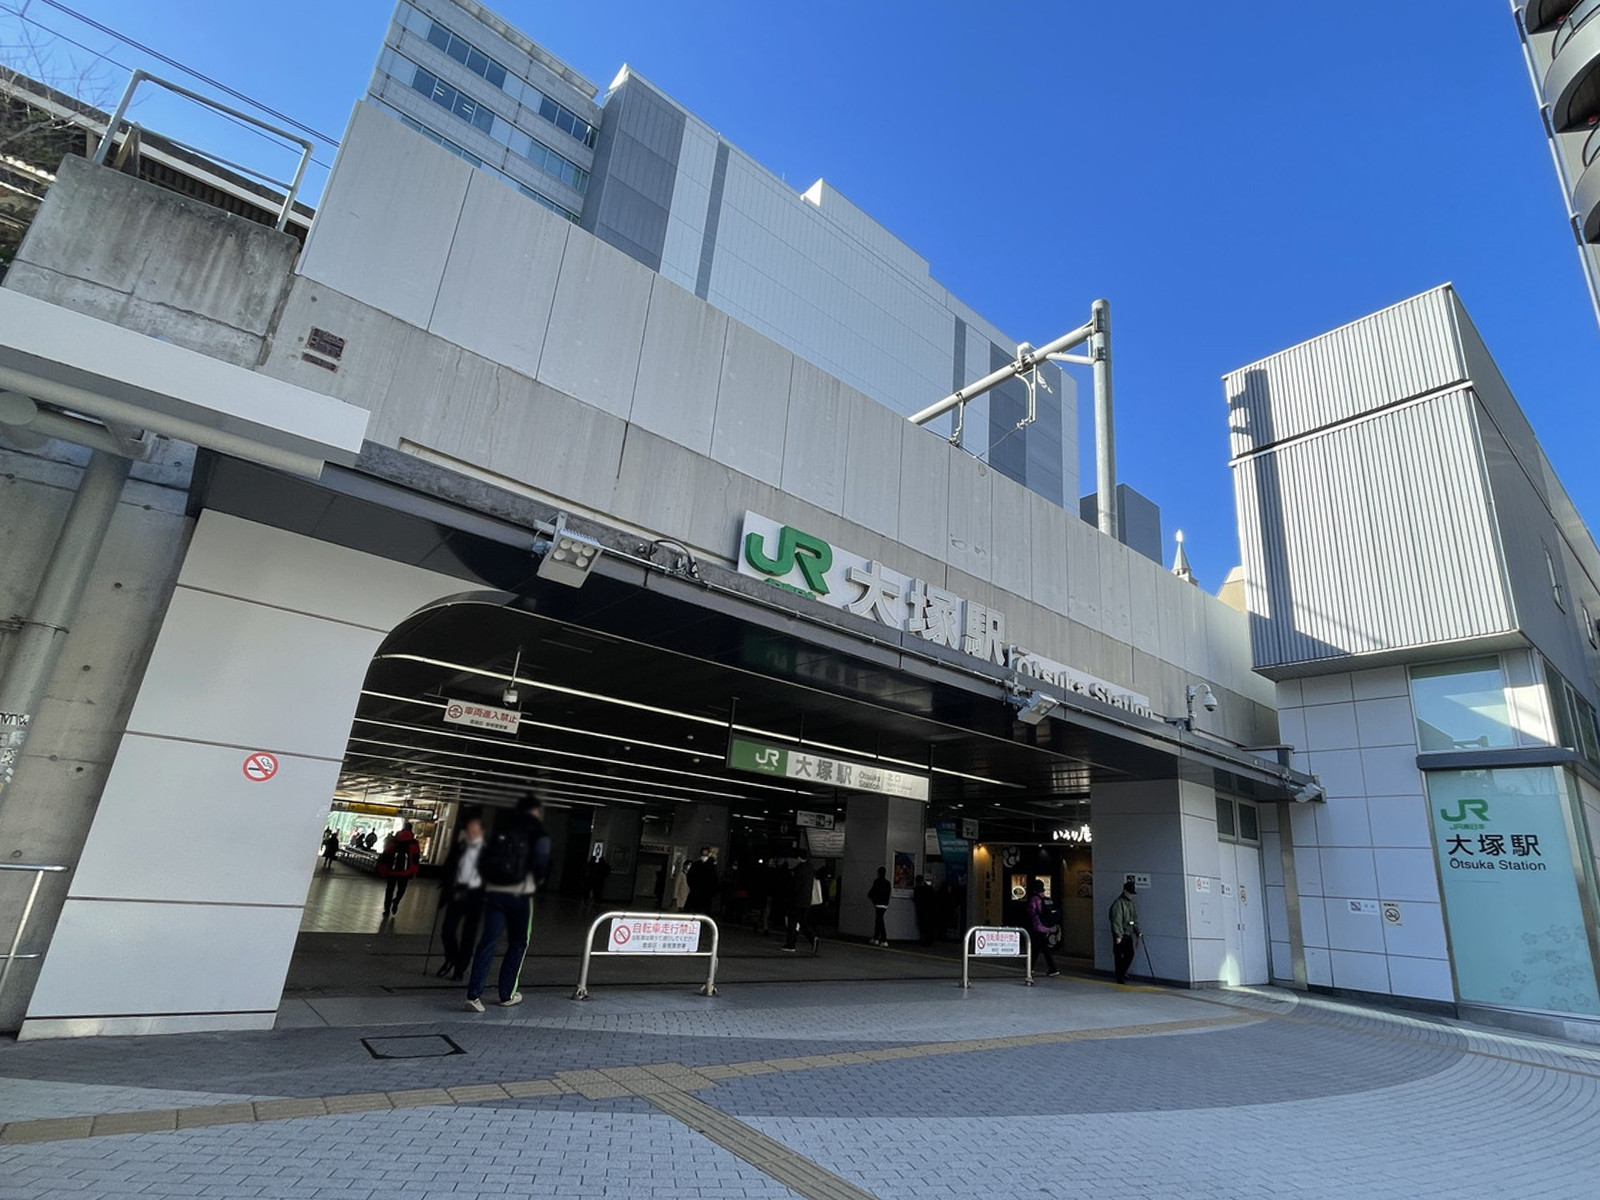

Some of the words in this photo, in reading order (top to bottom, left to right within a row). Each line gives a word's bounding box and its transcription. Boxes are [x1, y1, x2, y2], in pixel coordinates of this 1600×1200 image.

[745, 525, 833, 596] JR
[843, 560, 1007, 667] 大塚駅
[755, 748, 780, 767] JR
[795, 755, 853, 785] 大塚駅
[1440, 799, 1491, 822] JR
[1450, 823, 1486, 831] JR東日本
[1446, 834, 1542, 857] 大塚駅
[1499, 859, 1547, 871] Station
[632, 922, 697, 935] 自転車走行禁止
